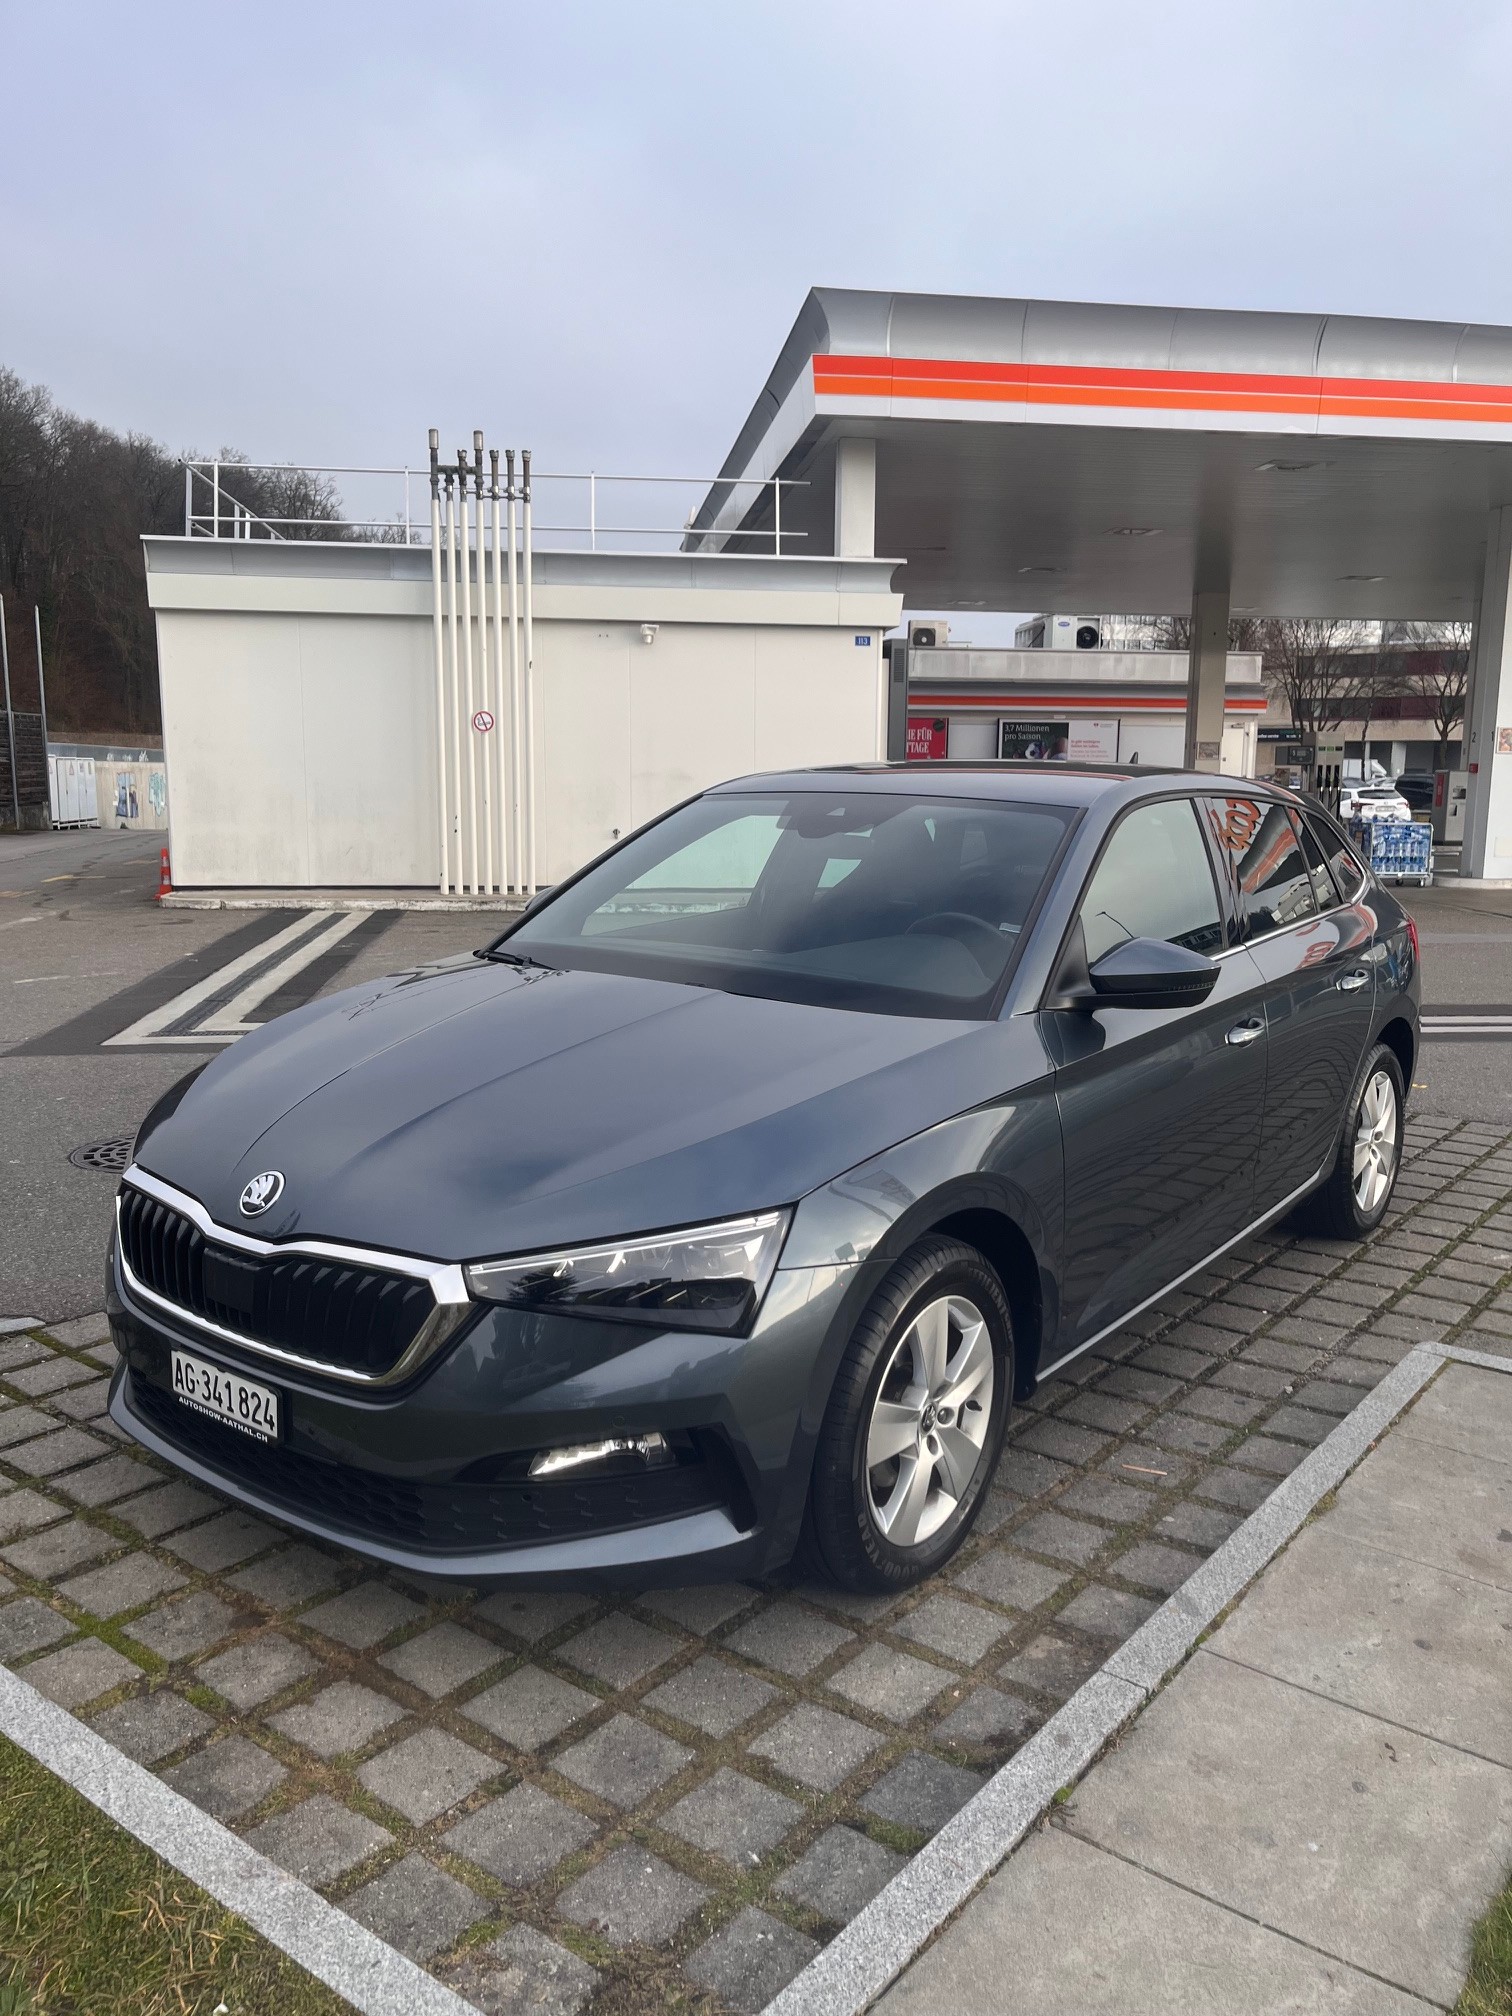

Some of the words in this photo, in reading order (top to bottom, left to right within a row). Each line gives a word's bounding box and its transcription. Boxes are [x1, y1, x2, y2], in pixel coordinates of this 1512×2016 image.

[1004, 724, 1014, 732] 3,7
[1015, 724, 1050, 732] Millionen
[917, 727, 932, 740] FÜR
